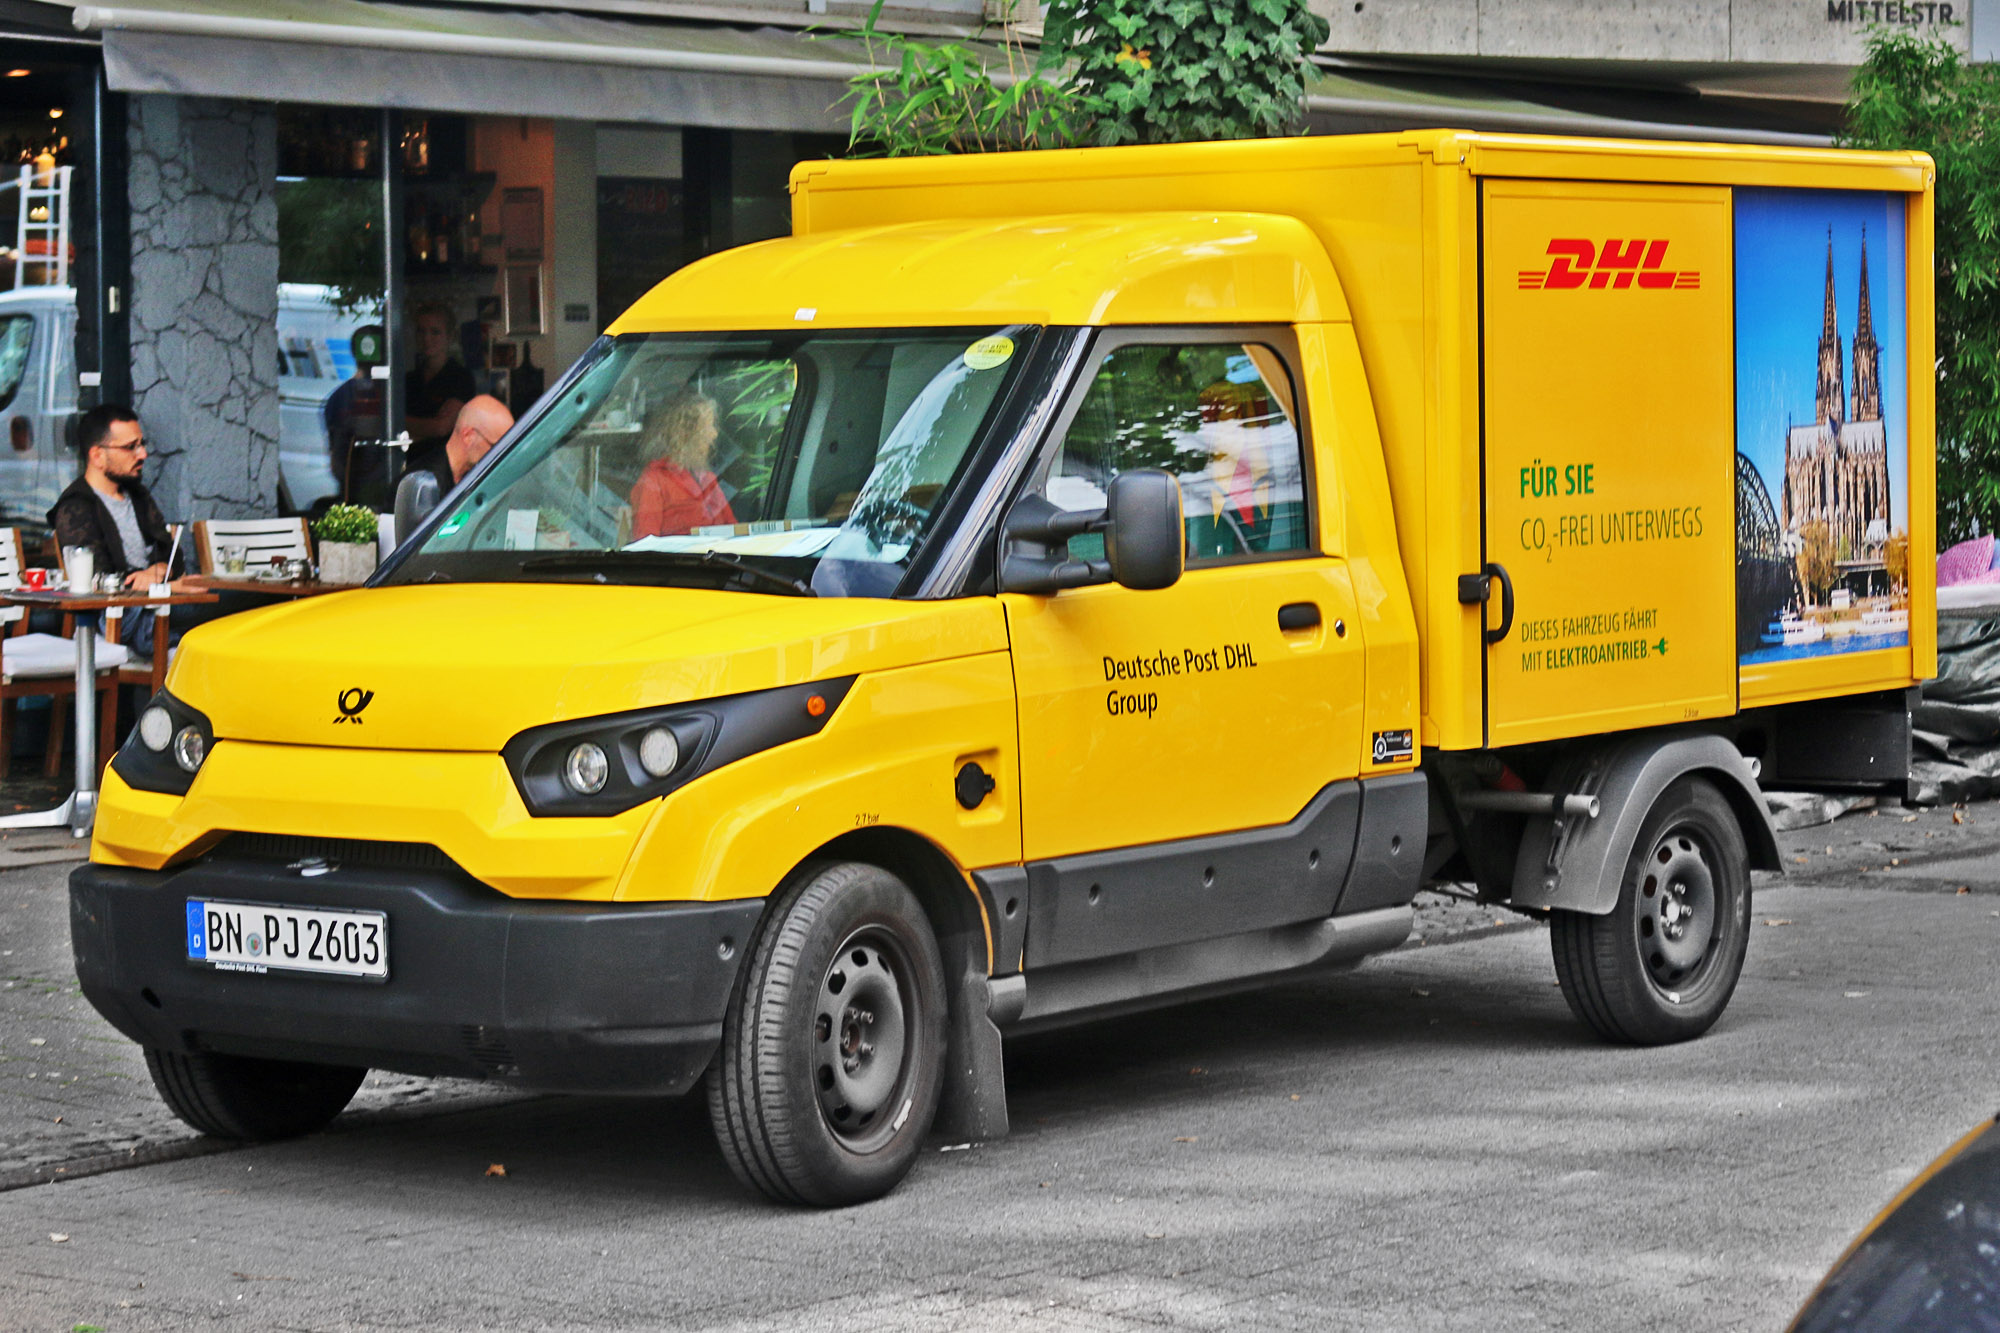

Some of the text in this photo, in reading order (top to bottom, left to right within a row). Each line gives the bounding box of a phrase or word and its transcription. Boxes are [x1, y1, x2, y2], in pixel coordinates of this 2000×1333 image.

[1544, 238, 1678, 289] DHL
[1520, 459, 1595, 498] FÜR SIE
[1600, 506, 1703, 545] UNTERWEGS
[1521, 606, 1658, 643] DIESES FAHRZEUG FÄHRT
[1103, 642, 1257, 681] Deutsche Post DHL
[1521, 638, 1651, 672] MIT ELEKTROANTRIEB.
[1106, 689, 1158, 719] Group
[207, 911, 380, 965] BN PJ 2603
